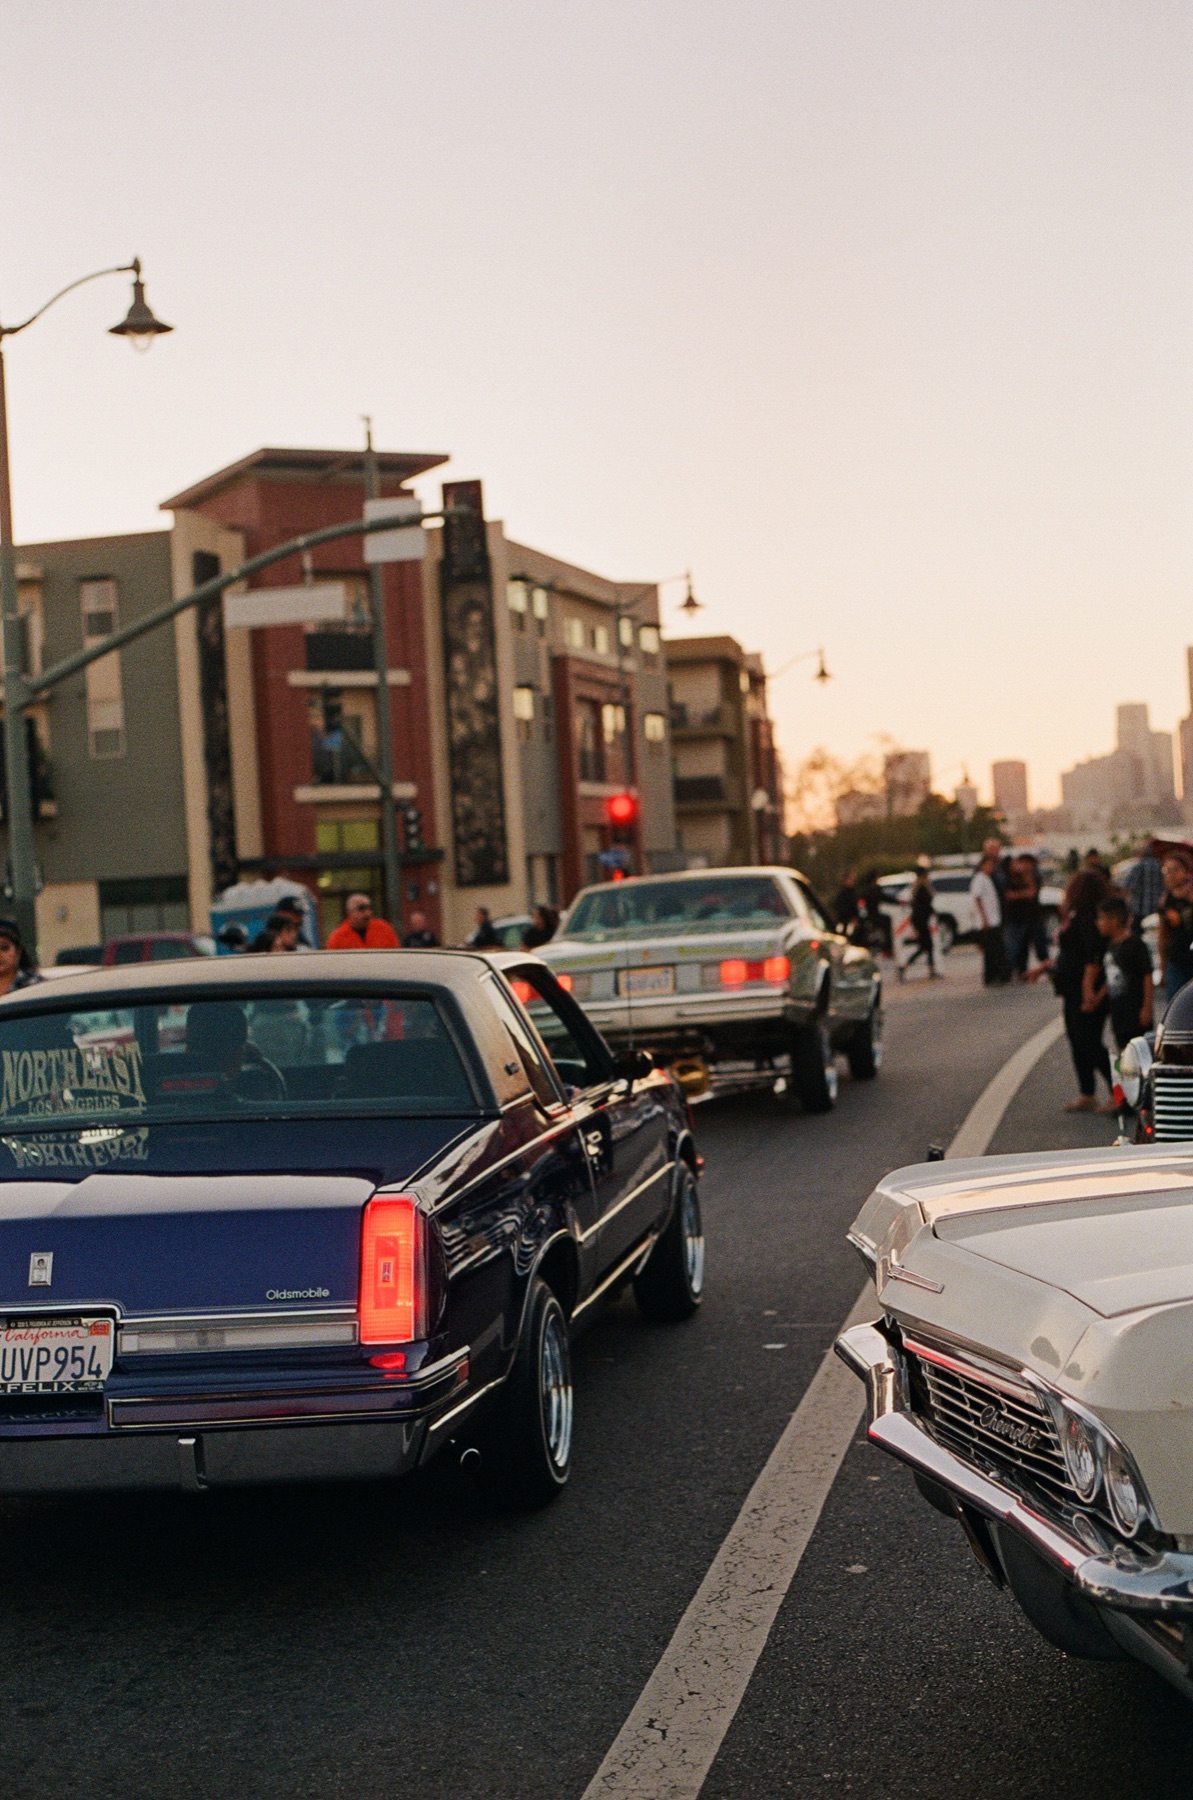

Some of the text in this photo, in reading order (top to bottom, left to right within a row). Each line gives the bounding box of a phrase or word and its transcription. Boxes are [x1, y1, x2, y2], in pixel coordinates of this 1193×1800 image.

[28, 1099, 53, 1115] LOS
[266, 1287, 330, 1300] Oldsmobile
[5, 1328, 87, 1345] California
[1, 1345, 102, 1381] UVP954
[7, 1381, 76, 1393] FELIX
[980, 1405, 1040, 1449] Chevrolet
